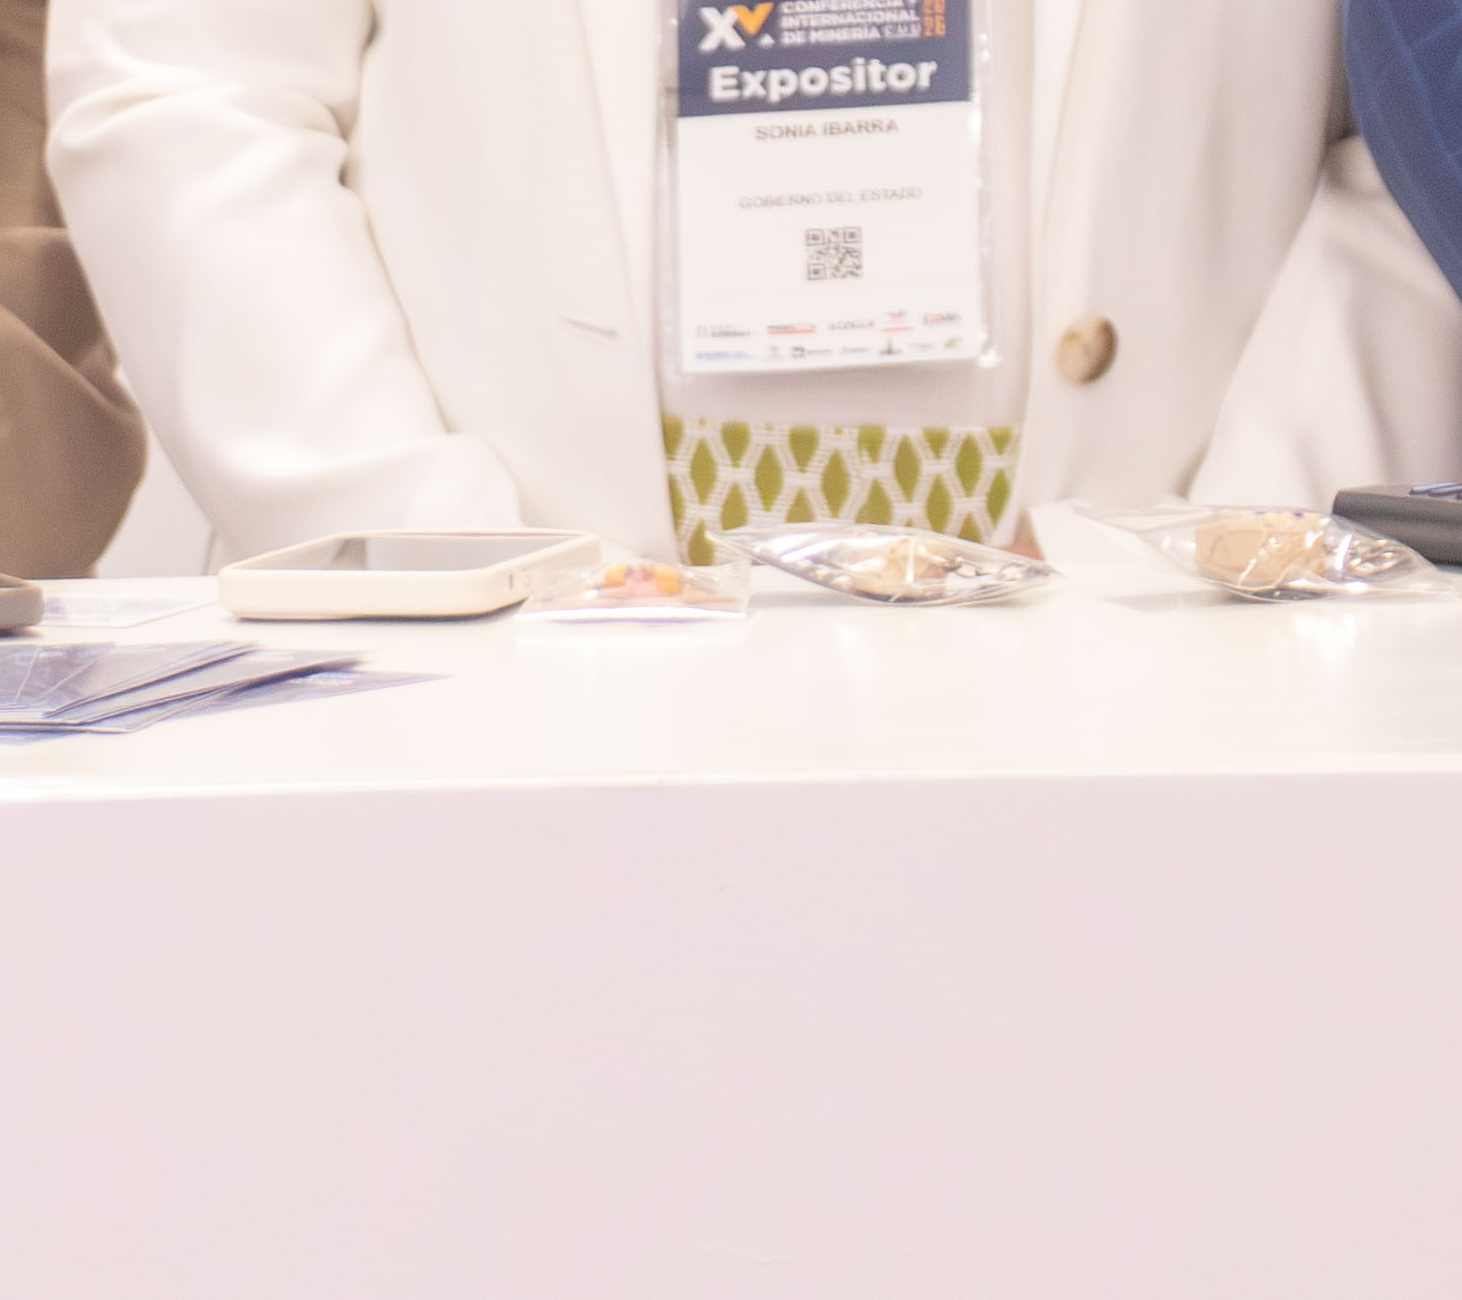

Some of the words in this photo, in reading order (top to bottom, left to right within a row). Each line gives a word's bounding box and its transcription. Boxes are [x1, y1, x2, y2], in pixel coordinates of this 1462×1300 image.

[780, 9, 920, 29] INTERNACIONAL
[710, 57, 938, 103] Expositor
[755, 123, 817, 140] SONIA
[823, 118, 899, 137] IBARRA
